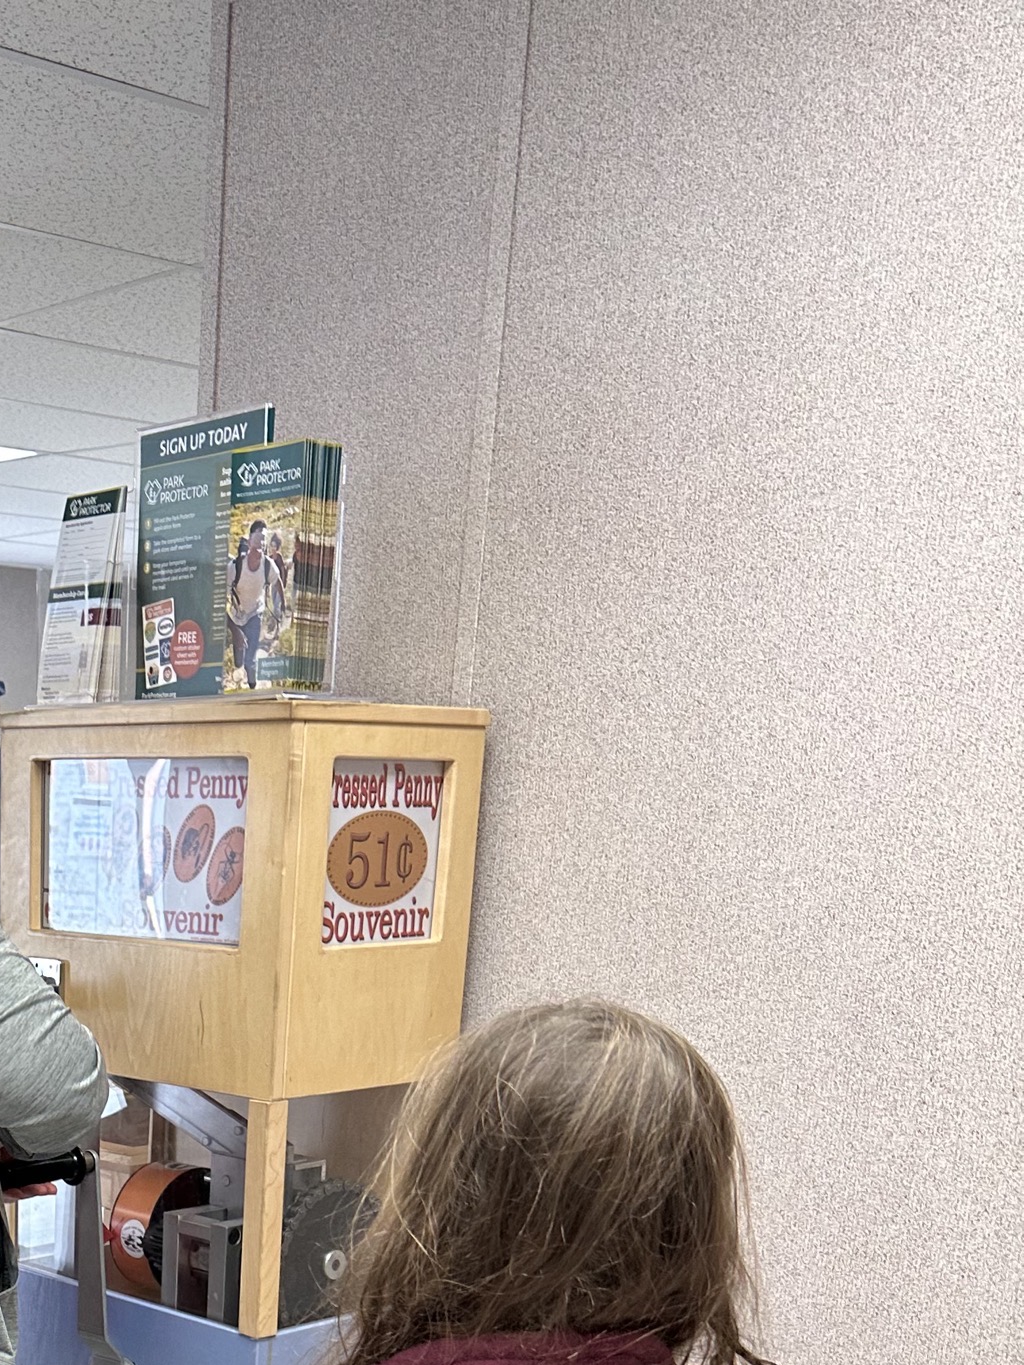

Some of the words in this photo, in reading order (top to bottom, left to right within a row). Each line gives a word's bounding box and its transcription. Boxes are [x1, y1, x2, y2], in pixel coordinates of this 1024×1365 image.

[159, 435, 187, 457] SIGN
[189, 432, 206, 450] UP
[207, 422, 248, 447] TODAY
[259, 458, 281, 473] PARK
[162, 474, 185, 489] PARK
[256, 467, 302, 486] PROTECTOR
[159, 483, 209, 504] PROTECTOR
[79, 502, 112, 516] PROTECTOR
[178, 631, 197, 644] FREE
[185, 766, 248, 809] Penny
[332, 763, 388, 809] ressed
[392, 763, 444, 821] Penny
[321, 896, 430, 944] Souvenir
